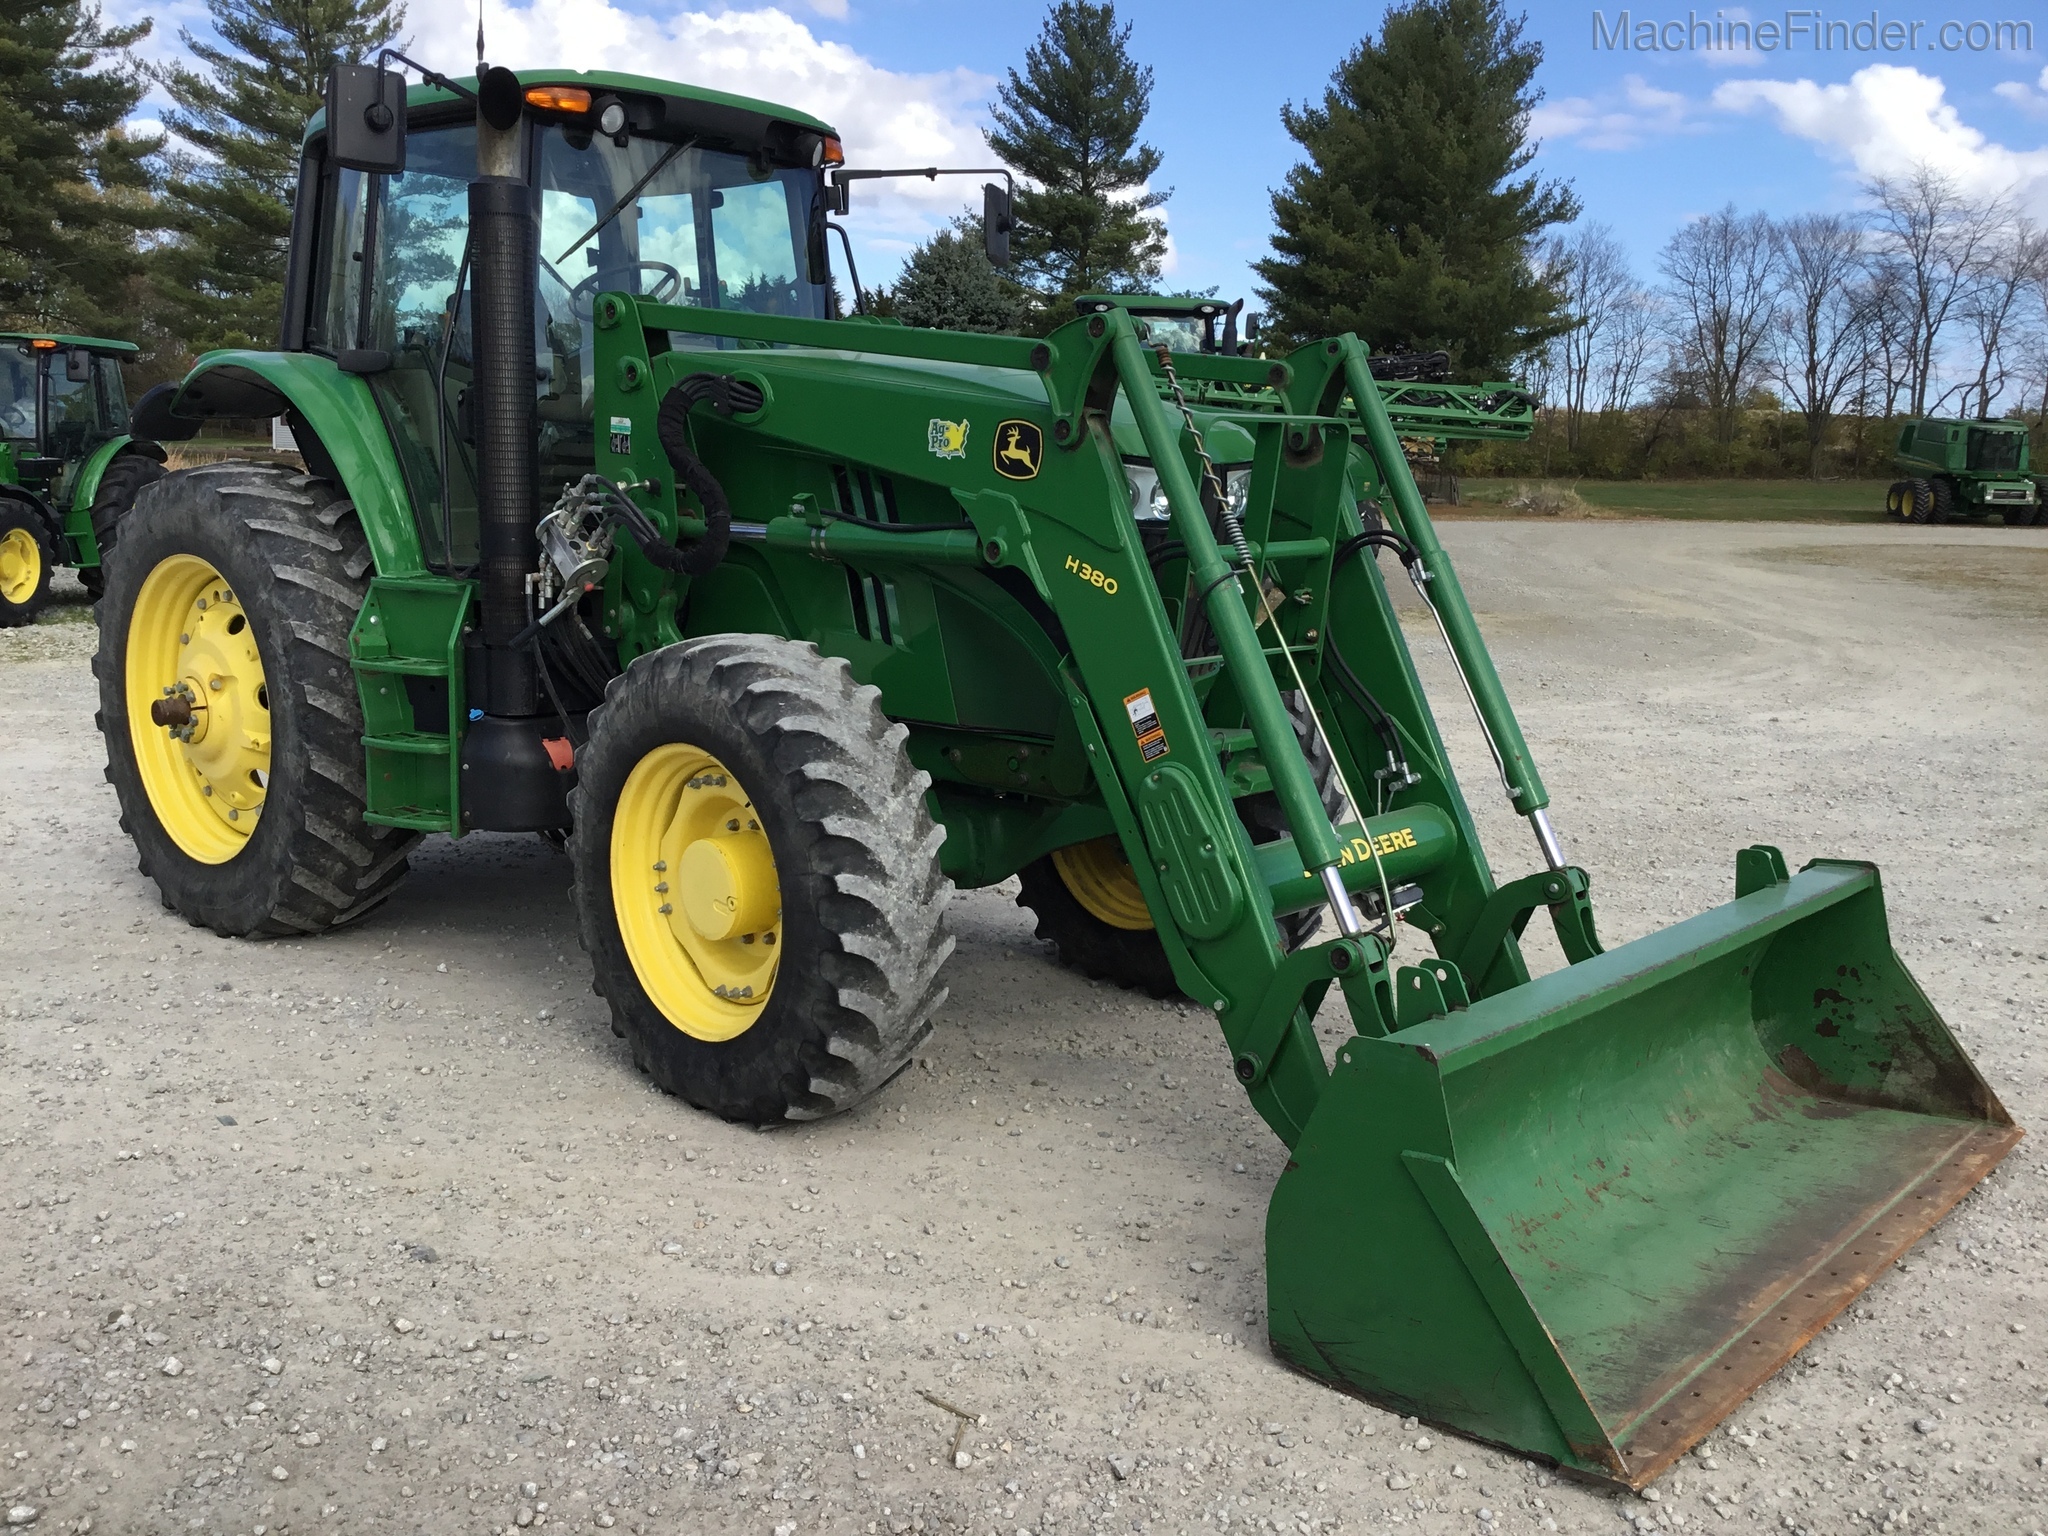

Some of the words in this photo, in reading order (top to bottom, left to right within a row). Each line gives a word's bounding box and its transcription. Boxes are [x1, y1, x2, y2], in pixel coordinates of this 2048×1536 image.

[930, 421, 949, 437] Ag-
[931, 435, 950, 448] Pro
[1350, 827, 1417, 862] DEERE
